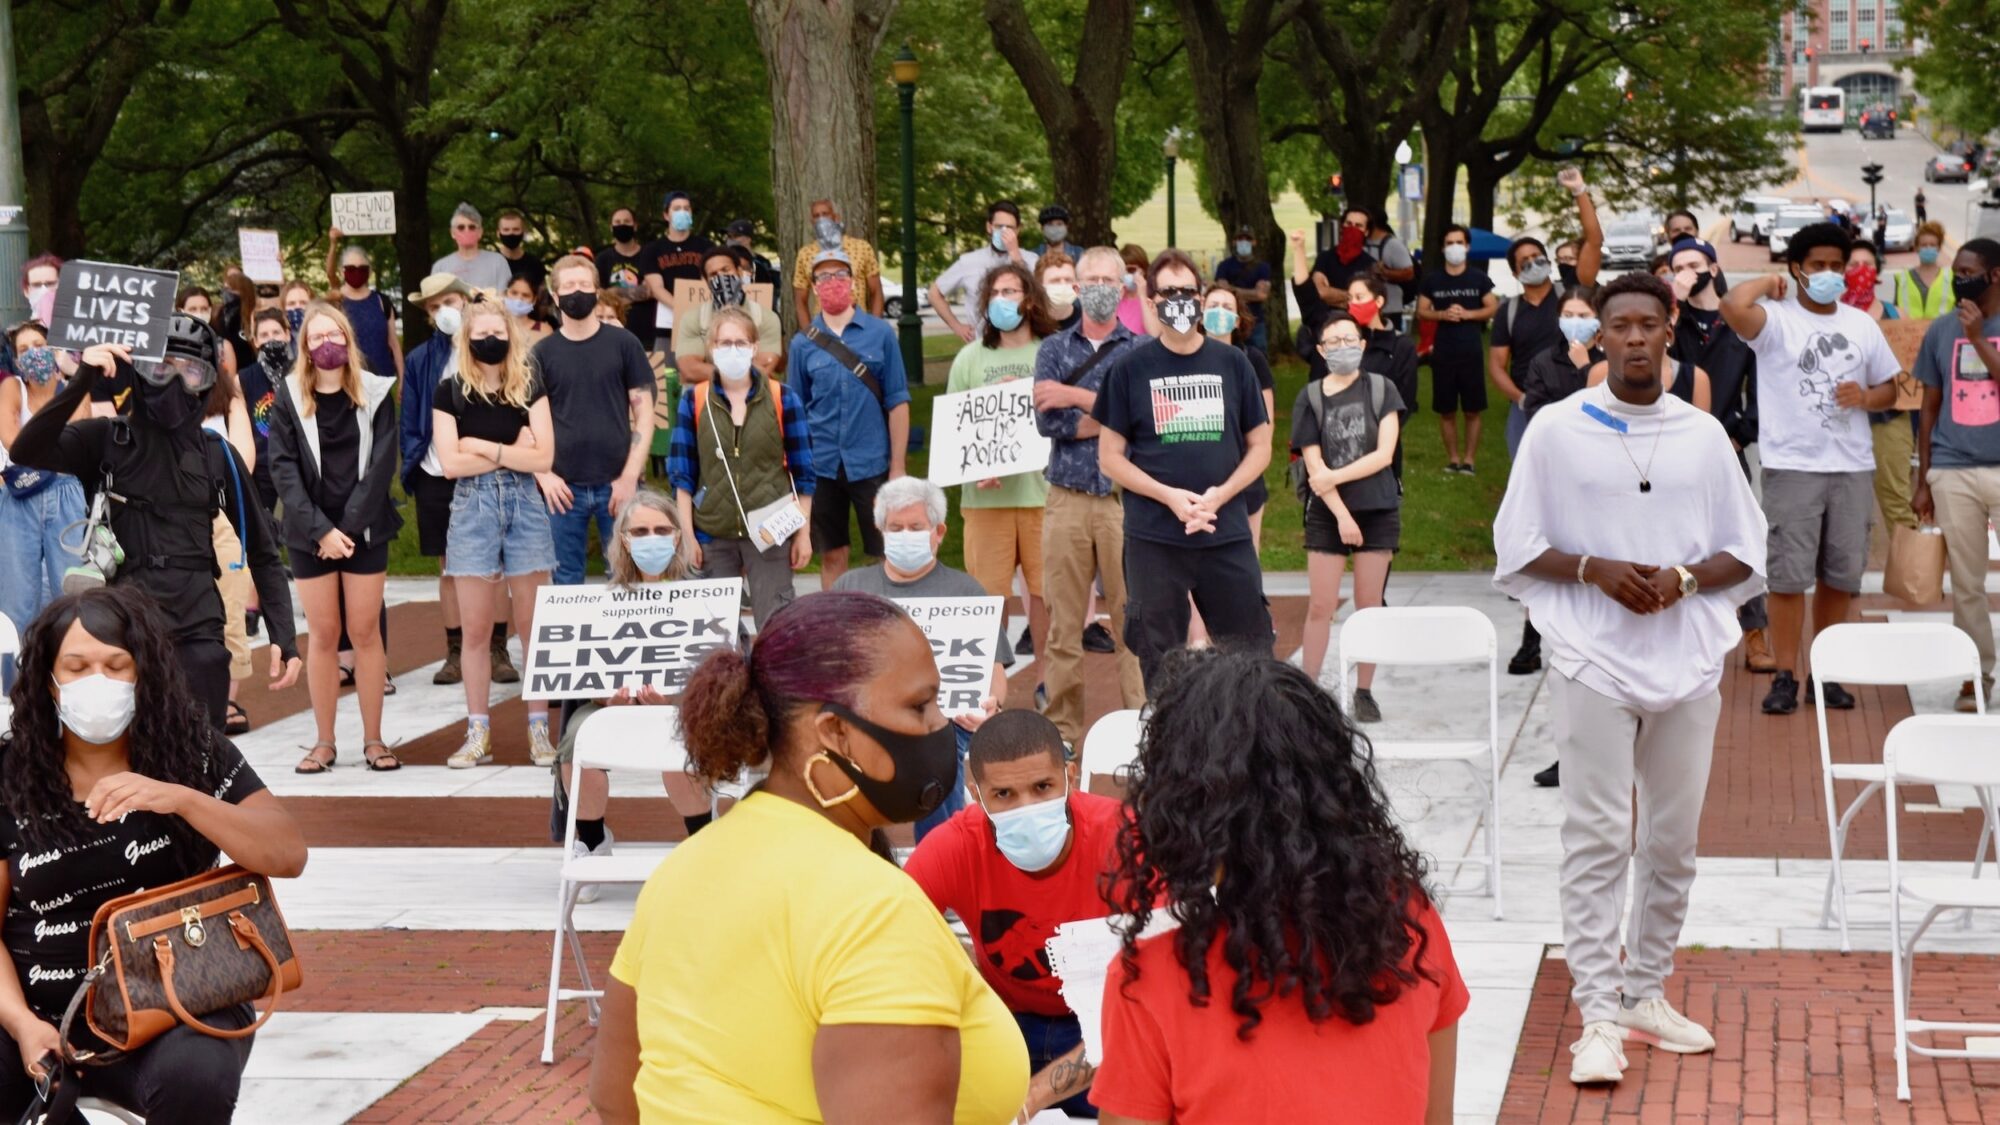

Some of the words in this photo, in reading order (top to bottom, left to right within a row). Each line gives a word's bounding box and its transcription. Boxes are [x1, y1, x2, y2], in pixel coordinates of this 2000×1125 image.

[333, 195, 393, 213] DEFUND
[338, 215, 393, 231] POLICE
[78, 271, 157, 298] BLACK
[73, 295, 151, 325] LIVES
[66, 323, 149, 349] MATTER
[545, 594, 603, 605] Another
[612, 588, 664, 602] white
[669, 585, 735, 603] person
[602, 605, 674, 619] supporting
[928, 604, 996, 620] person
[538, 617, 729, 643] BLACK
[531, 667, 692, 692] MATTE
[125, 834, 172, 866] Guess
[19, 848, 62, 877] Guess
[30, 893, 73, 916] Guess
[34, 919, 79, 943] Guess
[28, 964, 76, 986] Guess
